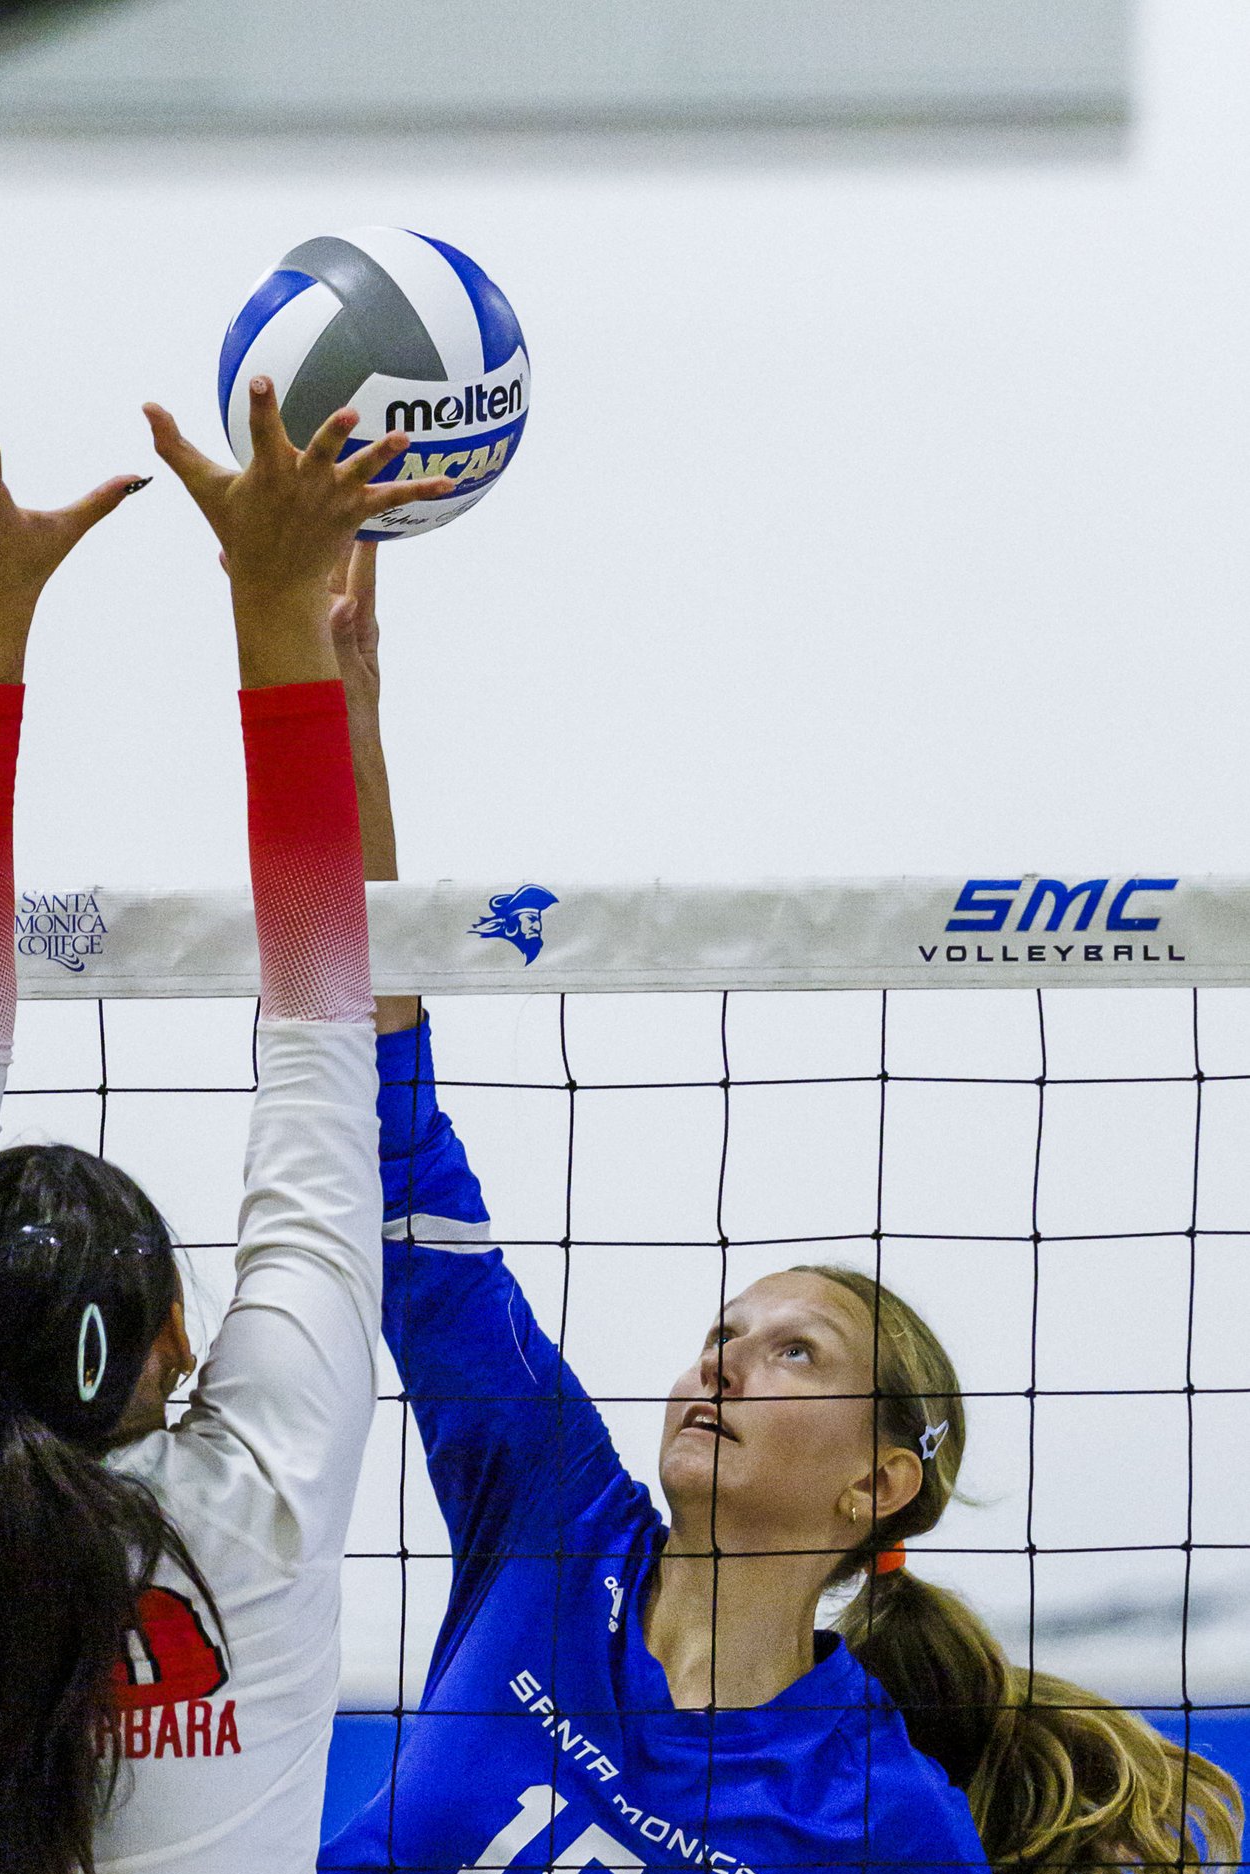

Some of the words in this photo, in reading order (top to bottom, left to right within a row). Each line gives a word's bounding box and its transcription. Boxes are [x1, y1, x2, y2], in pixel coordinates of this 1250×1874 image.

[386, 379, 522, 434] molten
[395, 436, 509, 484] NCAA
[14, 914, 108, 934] MONICA
[21, 891, 100, 914] SANTA
[944, 878, 1180, 932] SMC
[18, 934, 103, 973] COLLEGE
[918, 943, 1186, 963] VOLLEYBALL
[509, 1669, 620, 1782] SANTA
